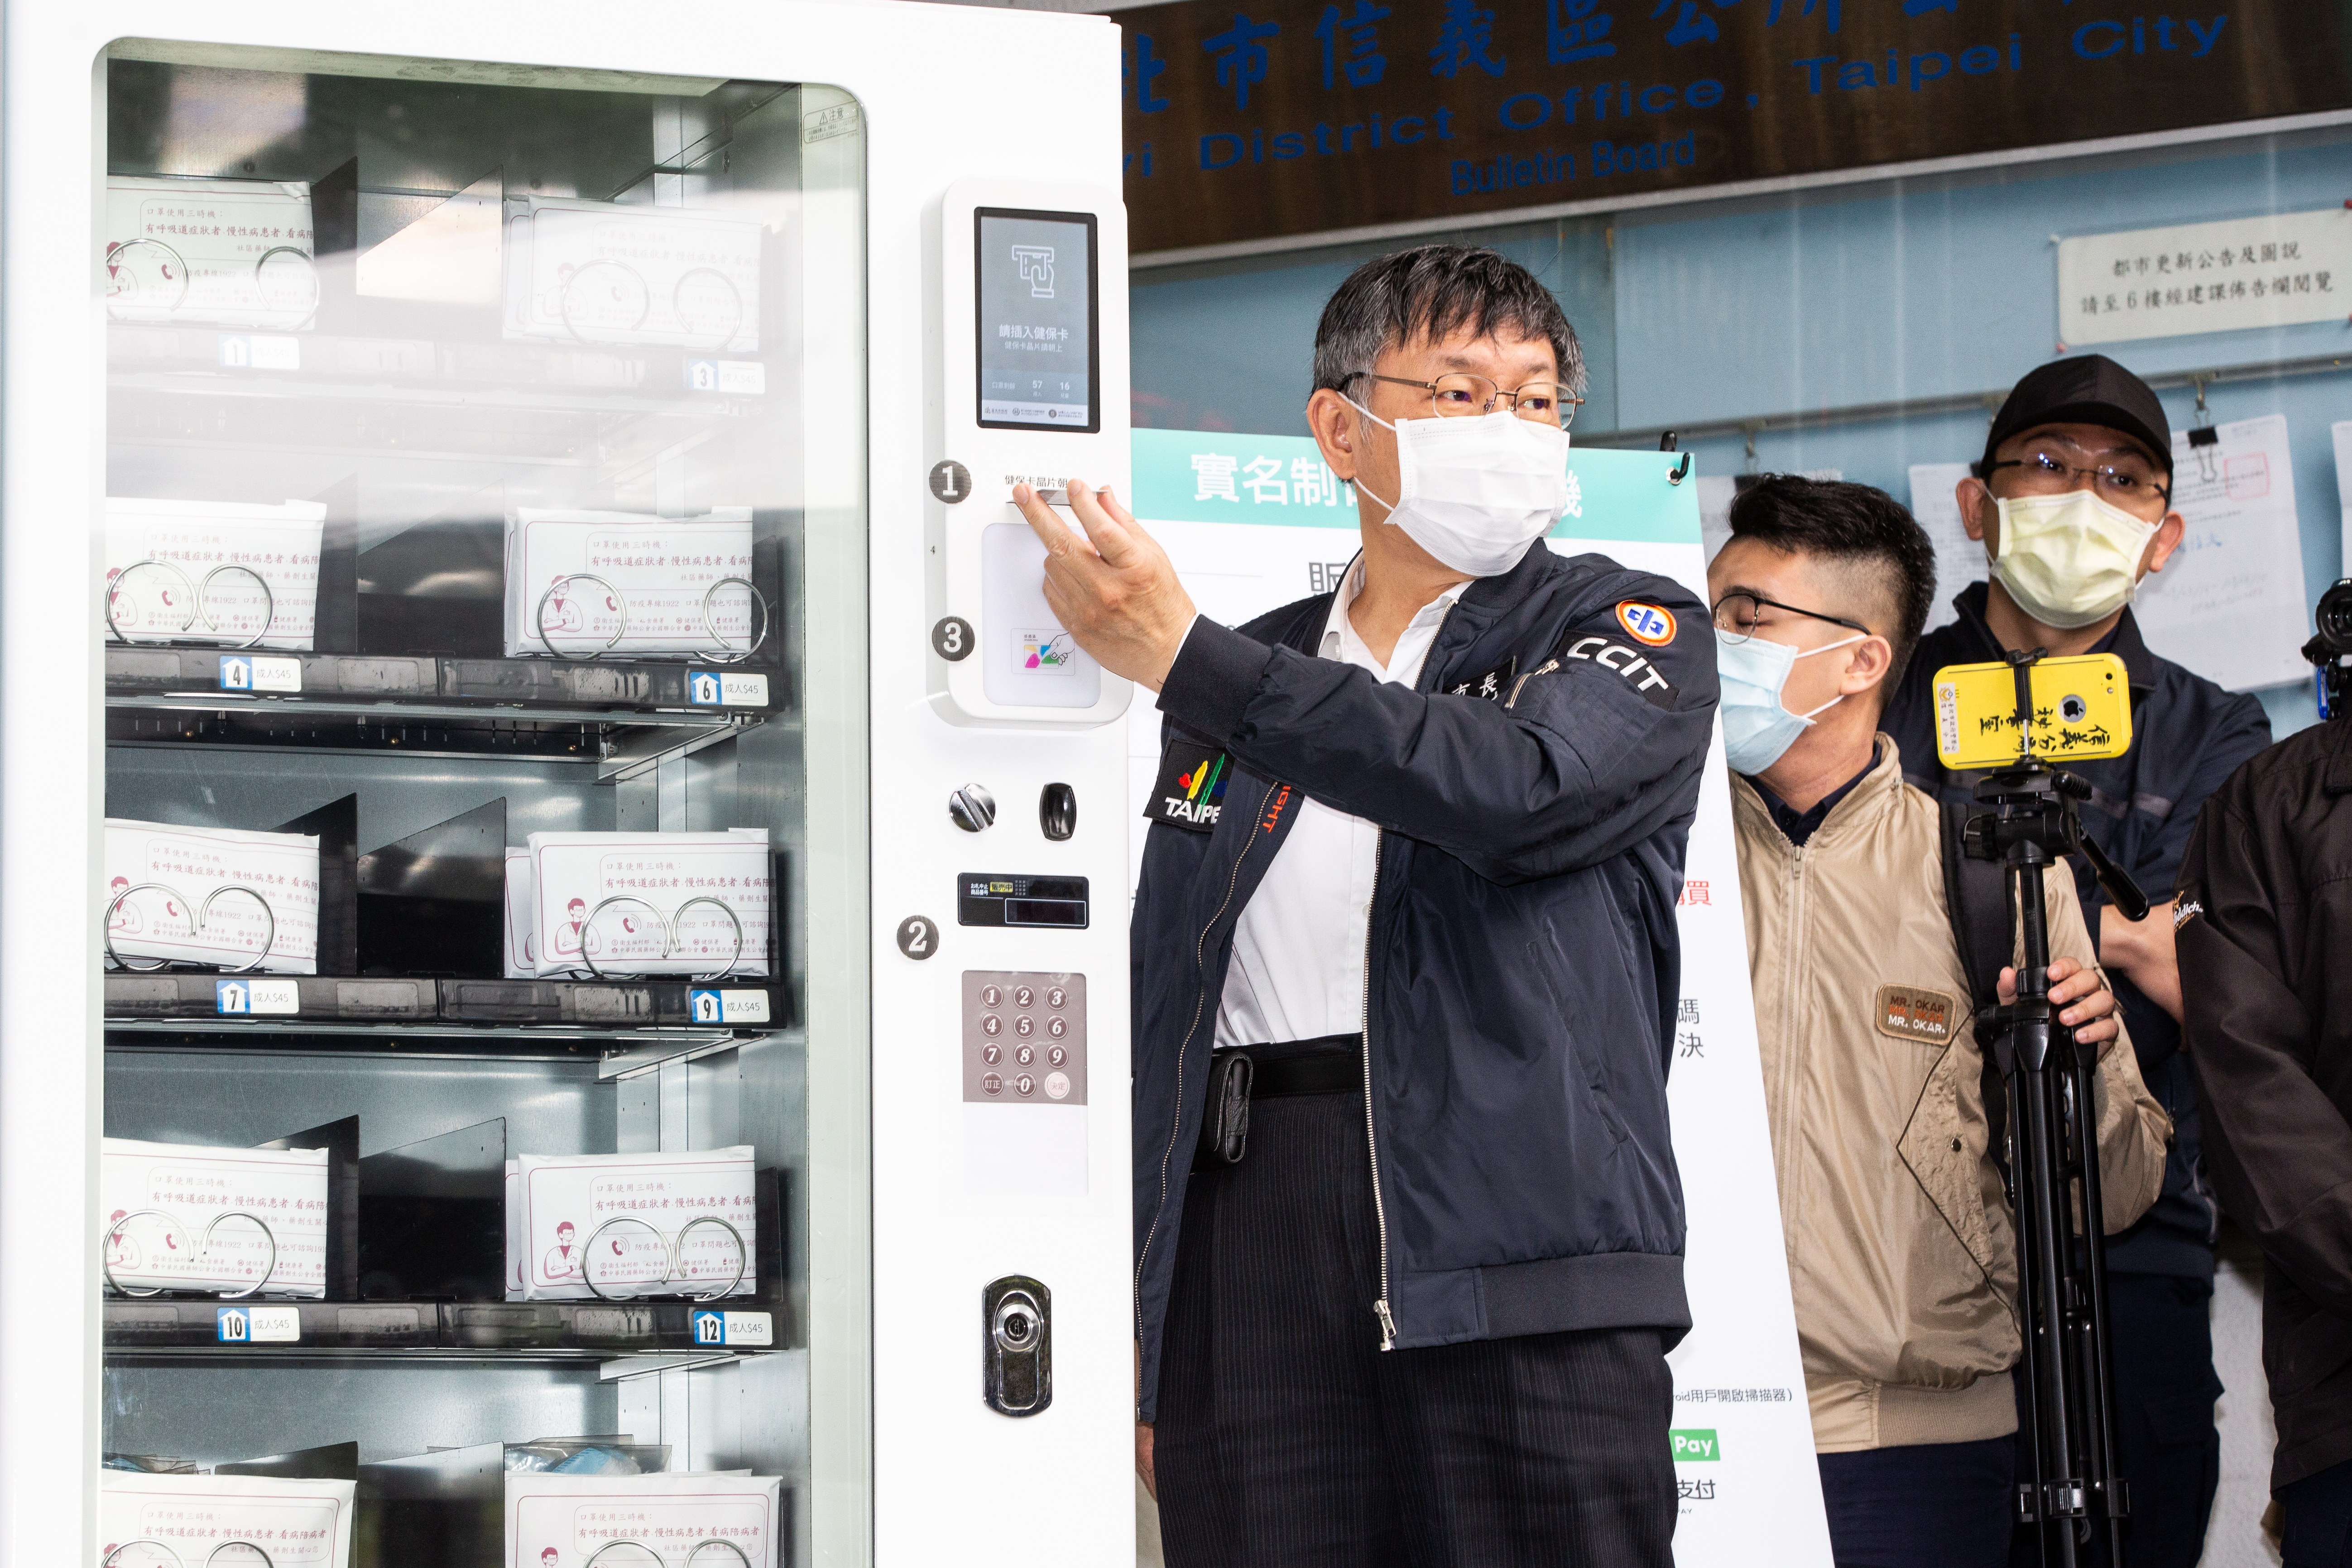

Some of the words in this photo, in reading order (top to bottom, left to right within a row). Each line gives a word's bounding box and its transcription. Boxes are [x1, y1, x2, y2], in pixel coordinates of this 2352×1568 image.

[1200, 107, 1455, 170] District
[1792, 33, 2021, 93] Taipei
[2072, 15, 2227, 58] City
[829, 107, 844, 121] 注意
[1452, 150, 1576, 196] Bulletin
[1592, 131, 1695, 177] Board
[999, 323, 1069, 341] 請插入健保卡
[701, 368, 707, 387] 3
[722, 373, 756, 385] 成人$45
[1032, 379, 1043, 389] 57
[1060, 382, 1070, 391] 16
[942, 465, 958, 496] 1
[186, 595, 236, 604] 防專線1922
[943, 622, 962, 653] 3
[233, 665, 241, 685] 4
[256, 666, 291, 679] 成人$45
[1566, 637, 1669, 692] CCIT
[703, 681, 710, 699] 6
[725, 683, 759, 695] 成人$45
[1165, 797, 1222, 825] TAIPE
[991, 882, 1012, 892] 販売中
[1680, 880, 1712, 906] 買
[908, 921, 927, 952] 2
[230, 989, 239, 1010] 7
[254, 993, 289, 1003] 成人$45
[988, 989, 996, 1004] 1
[1019, 990, 1030, 1005] 2
[1051, 991, 1061, 1006] 3
[1915, 999, 1945, 1014] OKAR
[703, 999, 711, 1019] 9
[726, 1001, 760, 1012] 成人$45
[1678, 998, 1700, 1025] 碼
[987, 1019, 997, 1033] 4
[1020, 1020, 1030, 1034] 5
[1052, 1020, 1062, 1035] 6
[988, 1048, 998, 1062] 7
[1019, 1049, 1030, 1063] 8
[1052, 1050, 1062, 1064] 9
[1678, 1032, 1704, 1059] 決
[984, 1079, 1000, 1089] 訂正
[1020, 1078, 1030, 1093] 0
[227, 1316, 243, 1338] 10
[254, 1319, 290, 1330] 成人$45
[703, 1319, 718, 1341] 12
[729, 1322, 763, 1333] 成人$45
[1674, 1435, 1713, 1458] Pay
[1677, 1479, 1716, 1500] 支付
